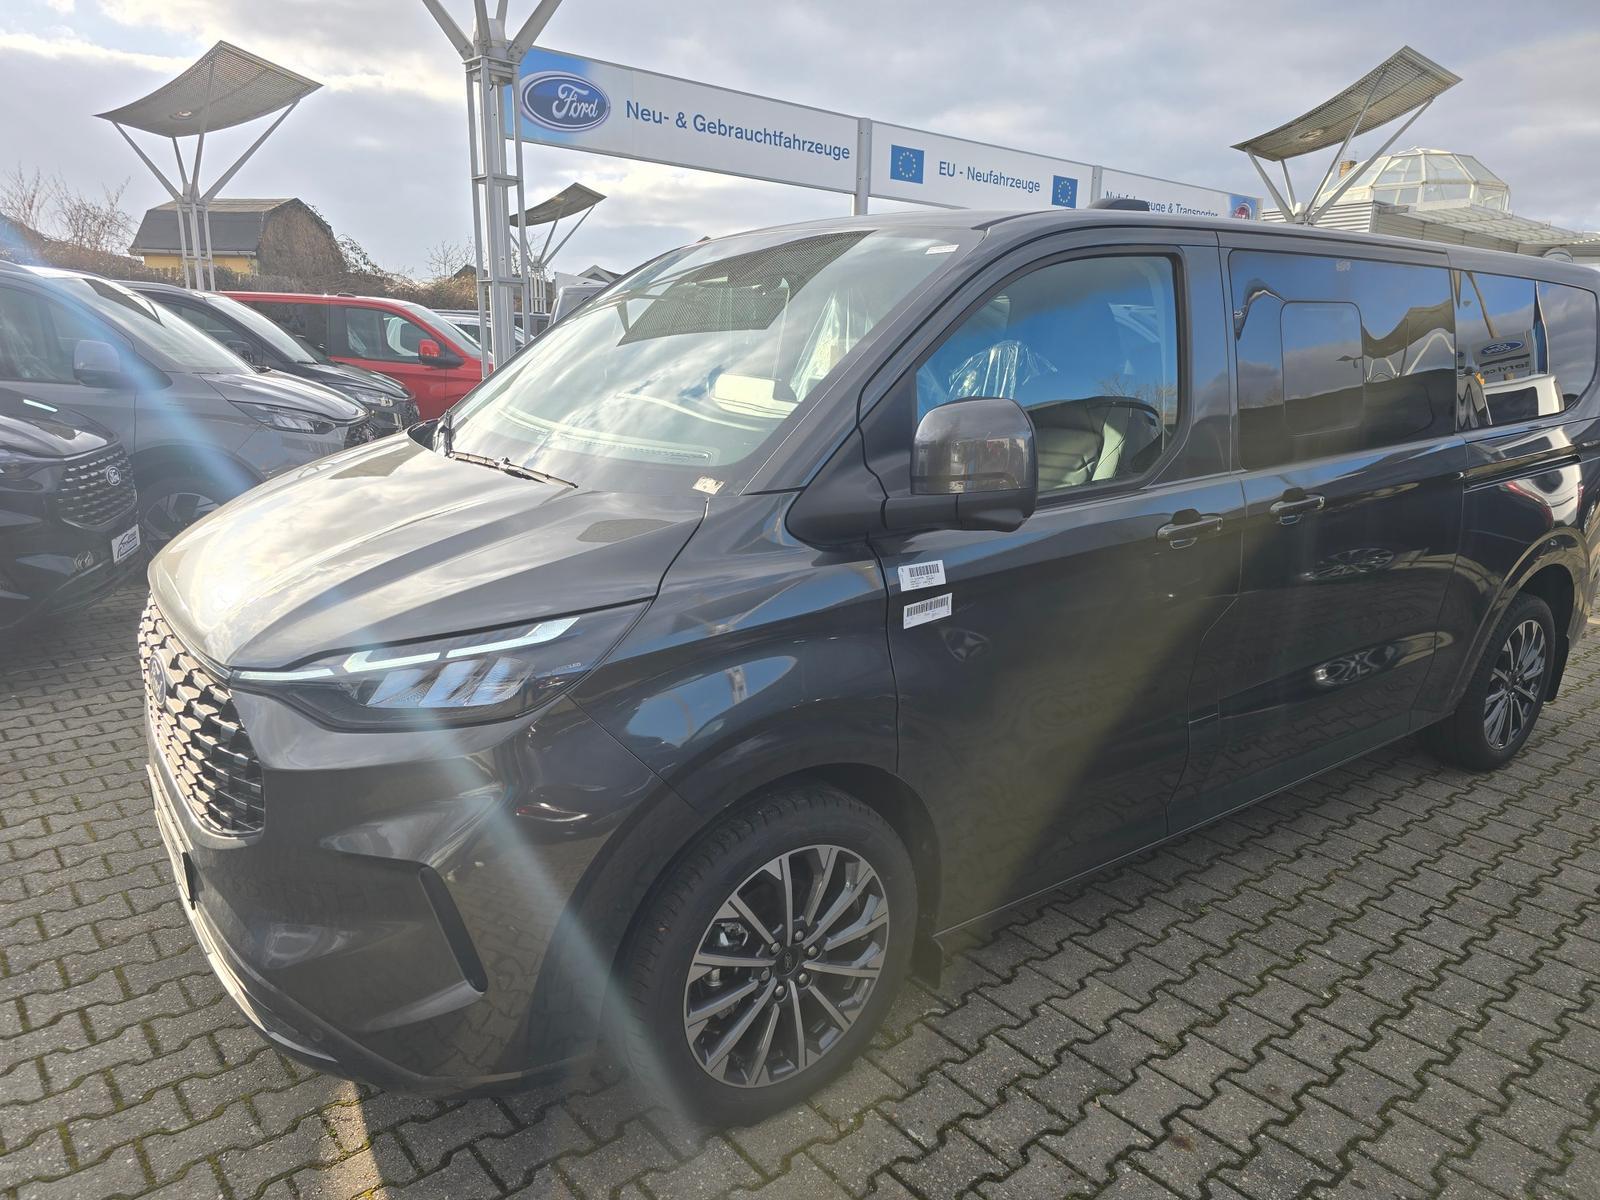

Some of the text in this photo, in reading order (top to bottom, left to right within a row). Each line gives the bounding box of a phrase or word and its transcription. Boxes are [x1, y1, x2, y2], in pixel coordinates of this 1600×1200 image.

[552, 83, 598, 119] Ford
[626, 100, 850, 161] Neu- & Gebrauchtfahrzeuge
[939, 161, 956, 177] EU
[967, 166, 1040, 193] Neufahrzeuge
[1167, 202, 1174, 214] &
